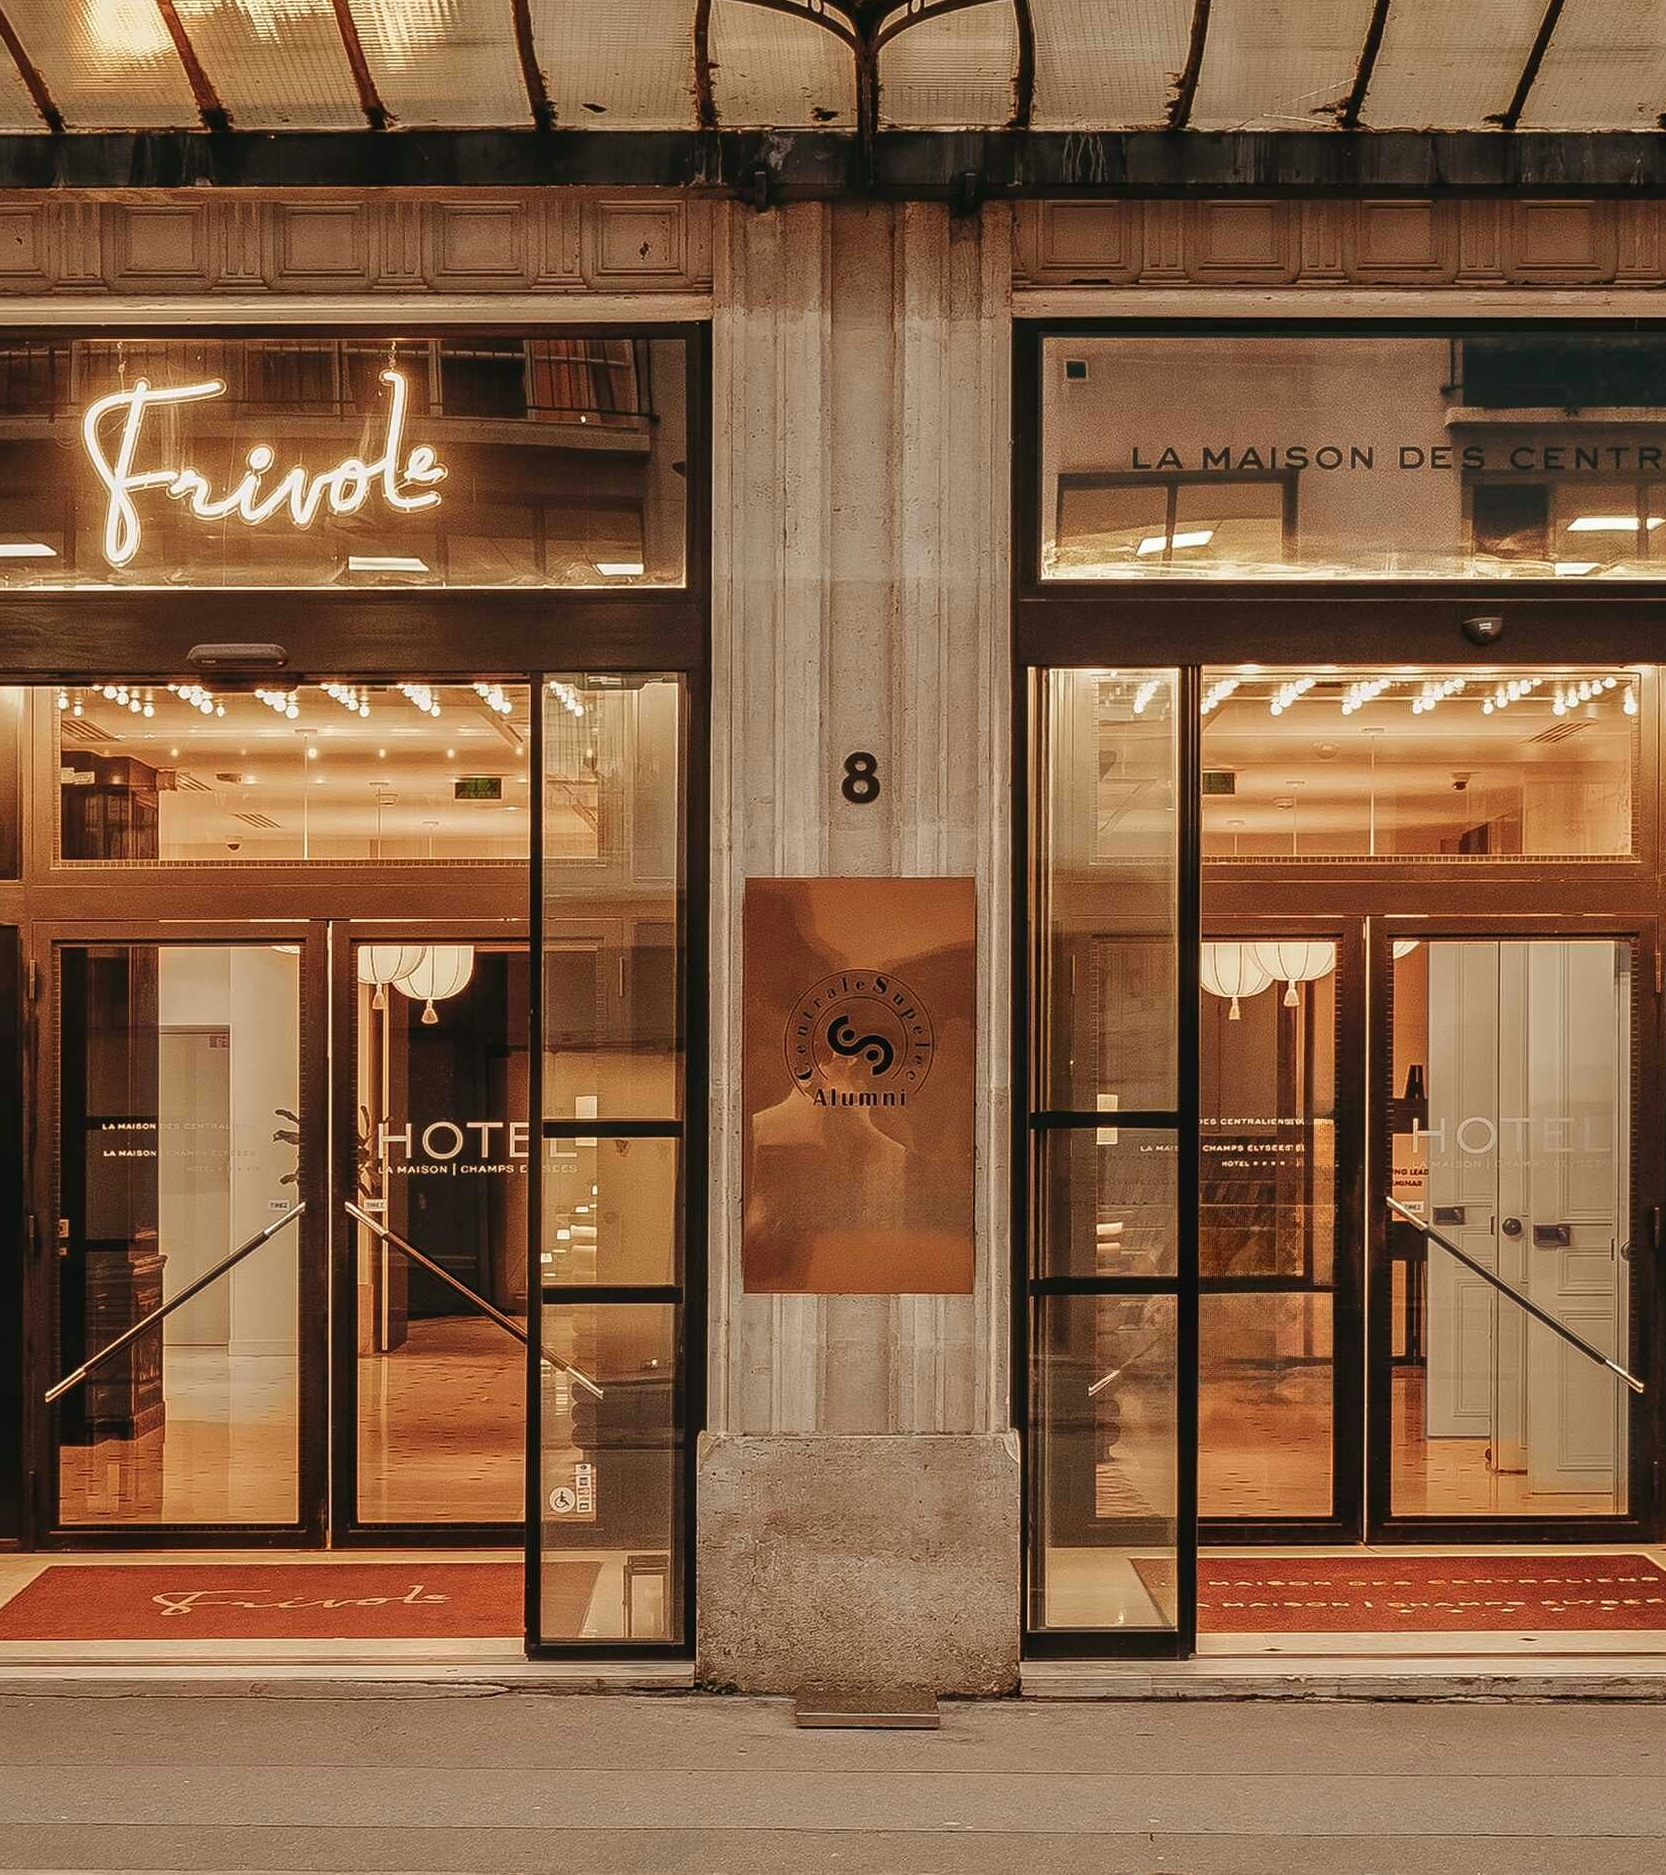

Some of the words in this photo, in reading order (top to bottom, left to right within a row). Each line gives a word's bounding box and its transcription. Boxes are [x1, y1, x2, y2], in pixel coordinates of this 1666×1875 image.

[82, 369, 448, 567] Frivole
[1131, 446, 1183, 470] LA
[1201, 446, 1374, 470] MAISON
[1398, 446, 1484, 470] DES
[841, 752, 880, 804] 8
[813, 1088, 907, 1107] Alumni
[102, 1123, 116, 1131] LA
[117, 1123, 156, 1131] MAISON
[1412, 1116, 1611, 1154] HOTEL
[397, 1165, 448, 1174] MAISON
[460, 1164, 515, 1174] CHAMPS
[151, 1584, 451, 1616] Frivole
